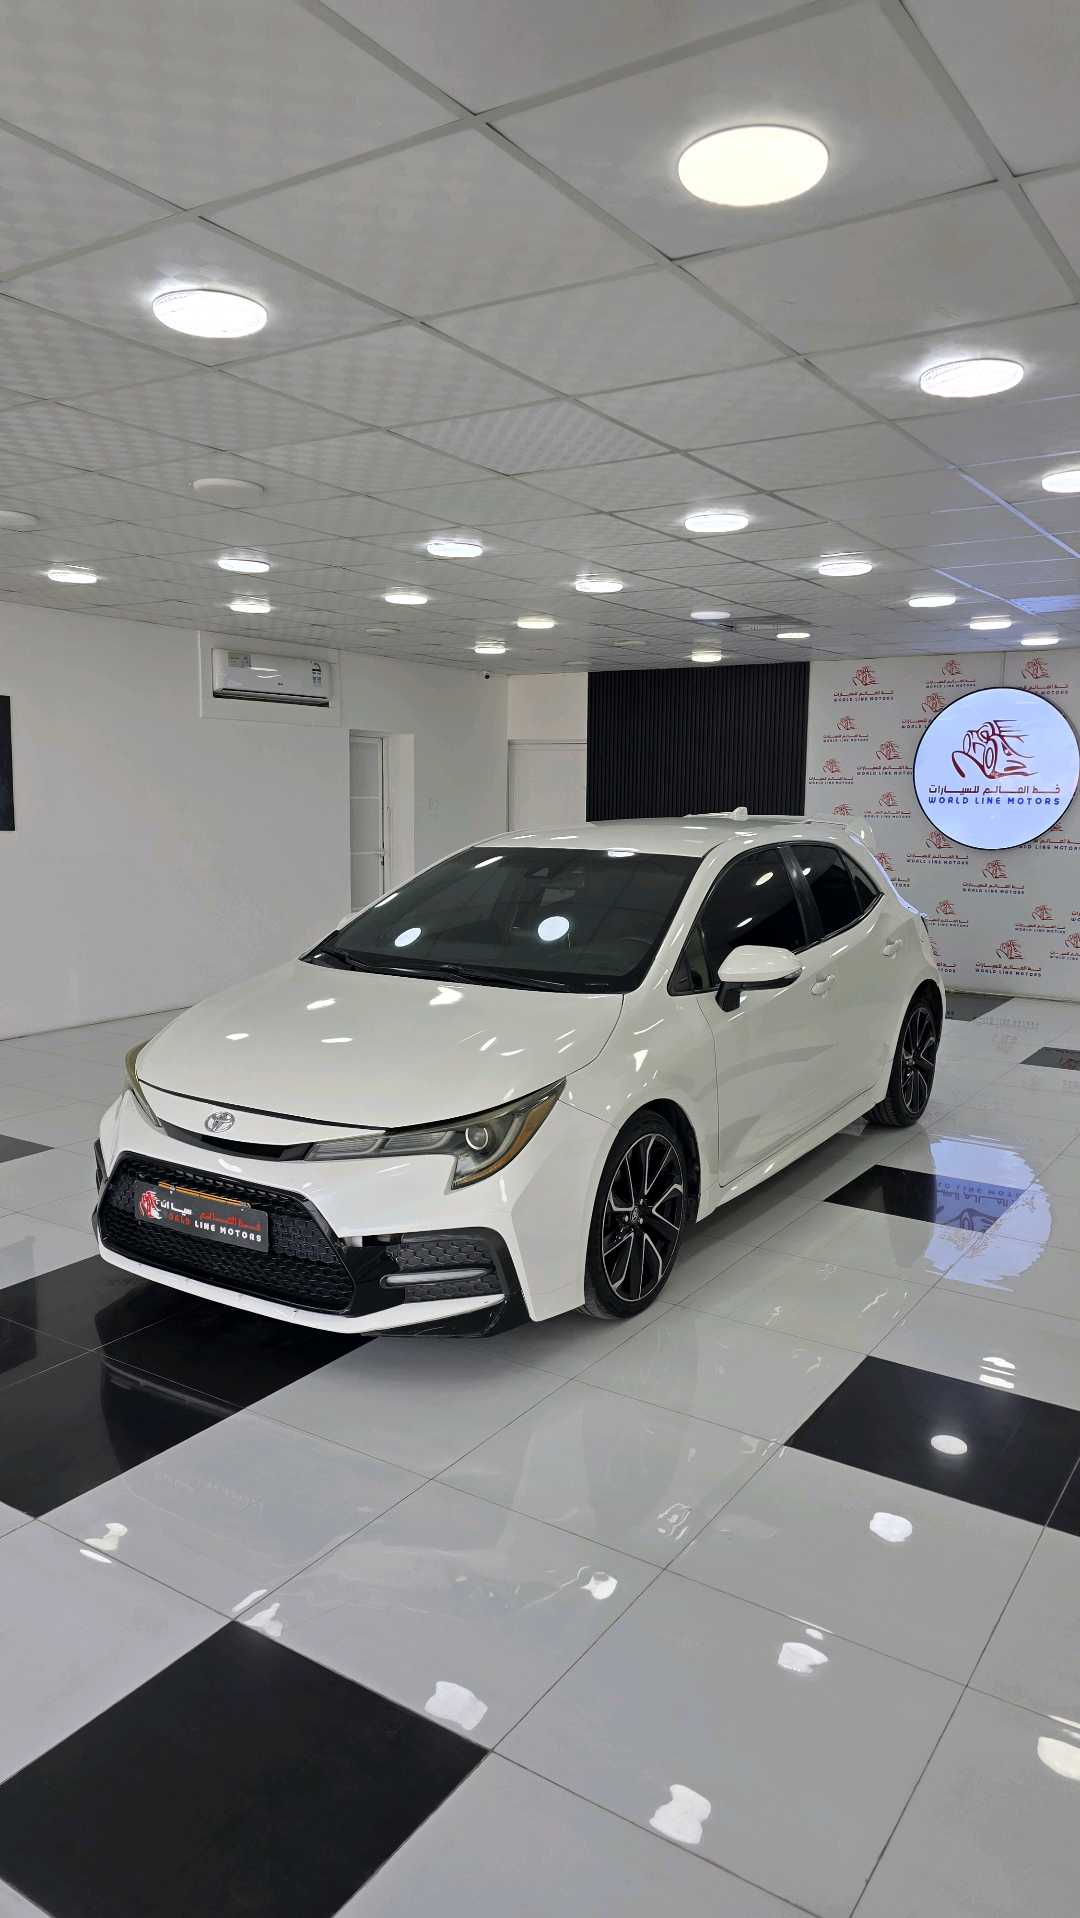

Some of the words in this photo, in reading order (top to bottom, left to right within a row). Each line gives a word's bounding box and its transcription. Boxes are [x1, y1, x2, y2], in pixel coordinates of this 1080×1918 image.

[928, 785, 980, 796] للسيارات
[982, 785, 1029, 796] العالم
[1032, 784, 1061, 794] خط
[928, 796, 969, 805] WORLD
[975, 796, 1001, 805] LINE
[1007, 797, 1061, 806] MOTORS
[194, 1220, 216, 1232] LINE
[220, 1226, 262, 1242] MOTORS
